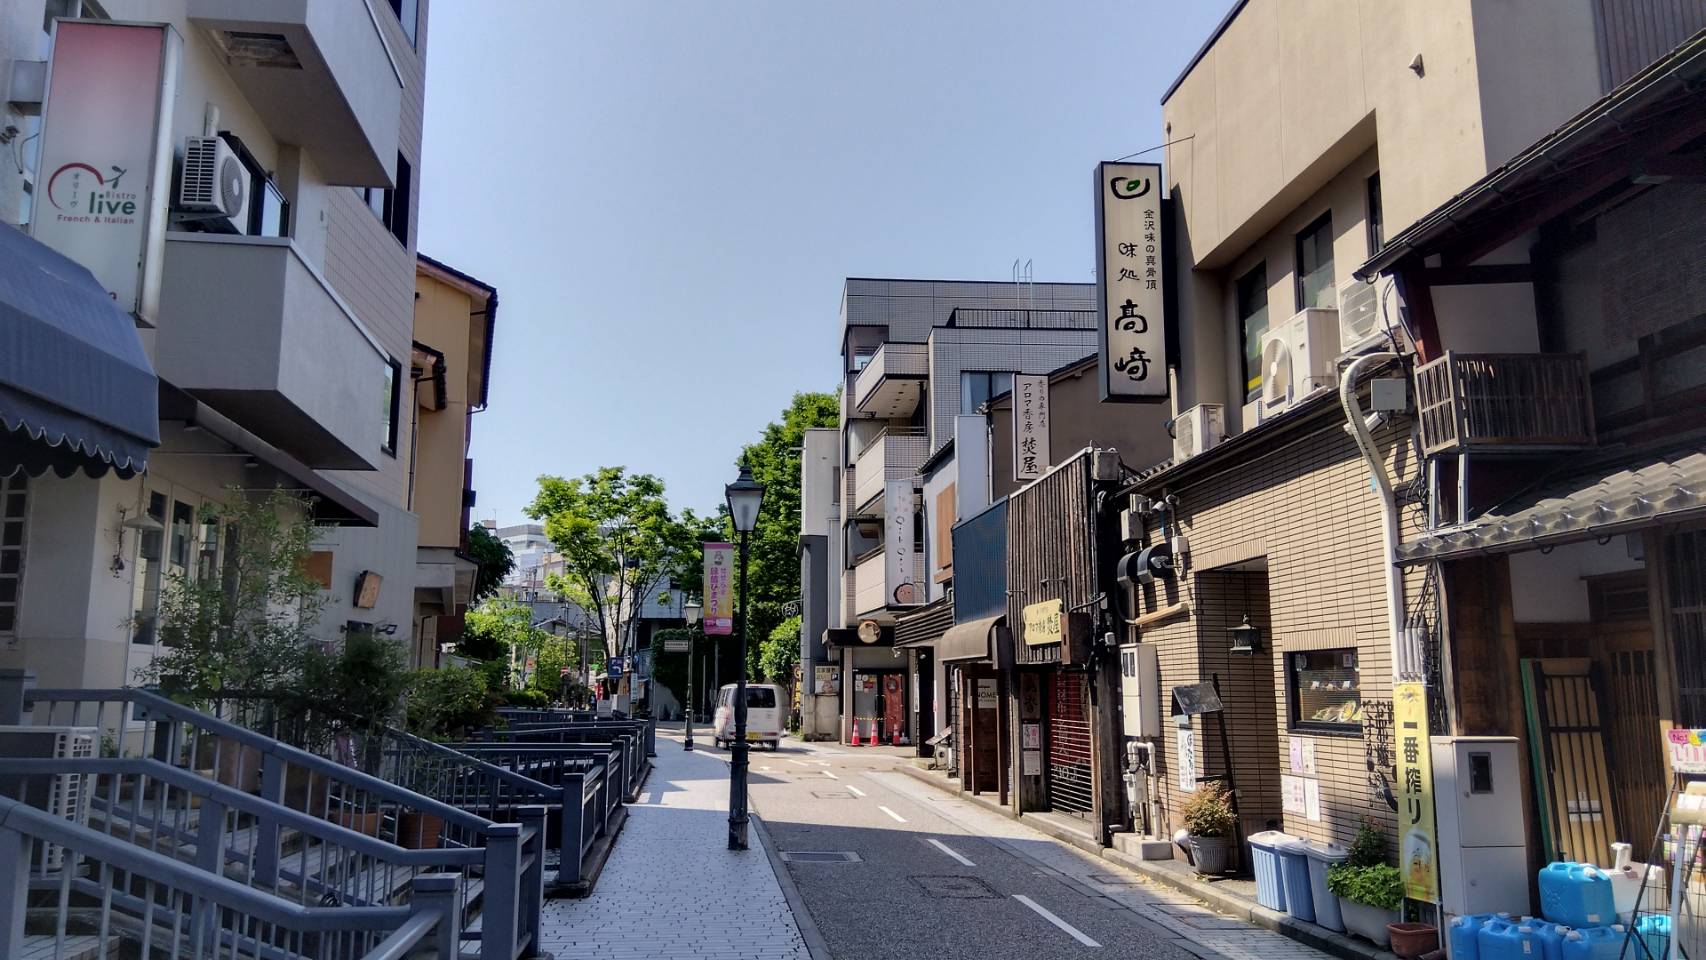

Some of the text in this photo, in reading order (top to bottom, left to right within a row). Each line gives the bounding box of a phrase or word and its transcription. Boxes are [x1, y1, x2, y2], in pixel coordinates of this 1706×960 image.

[105, 191, 136, 200] Bistro
[57, 214, 90, 223] French
[104, 217, 134, 225] Italian
[1144, 208, 1157, 291] 金沢味の真骨頂
[1403, 721, 1422, 825] 一番搾り
